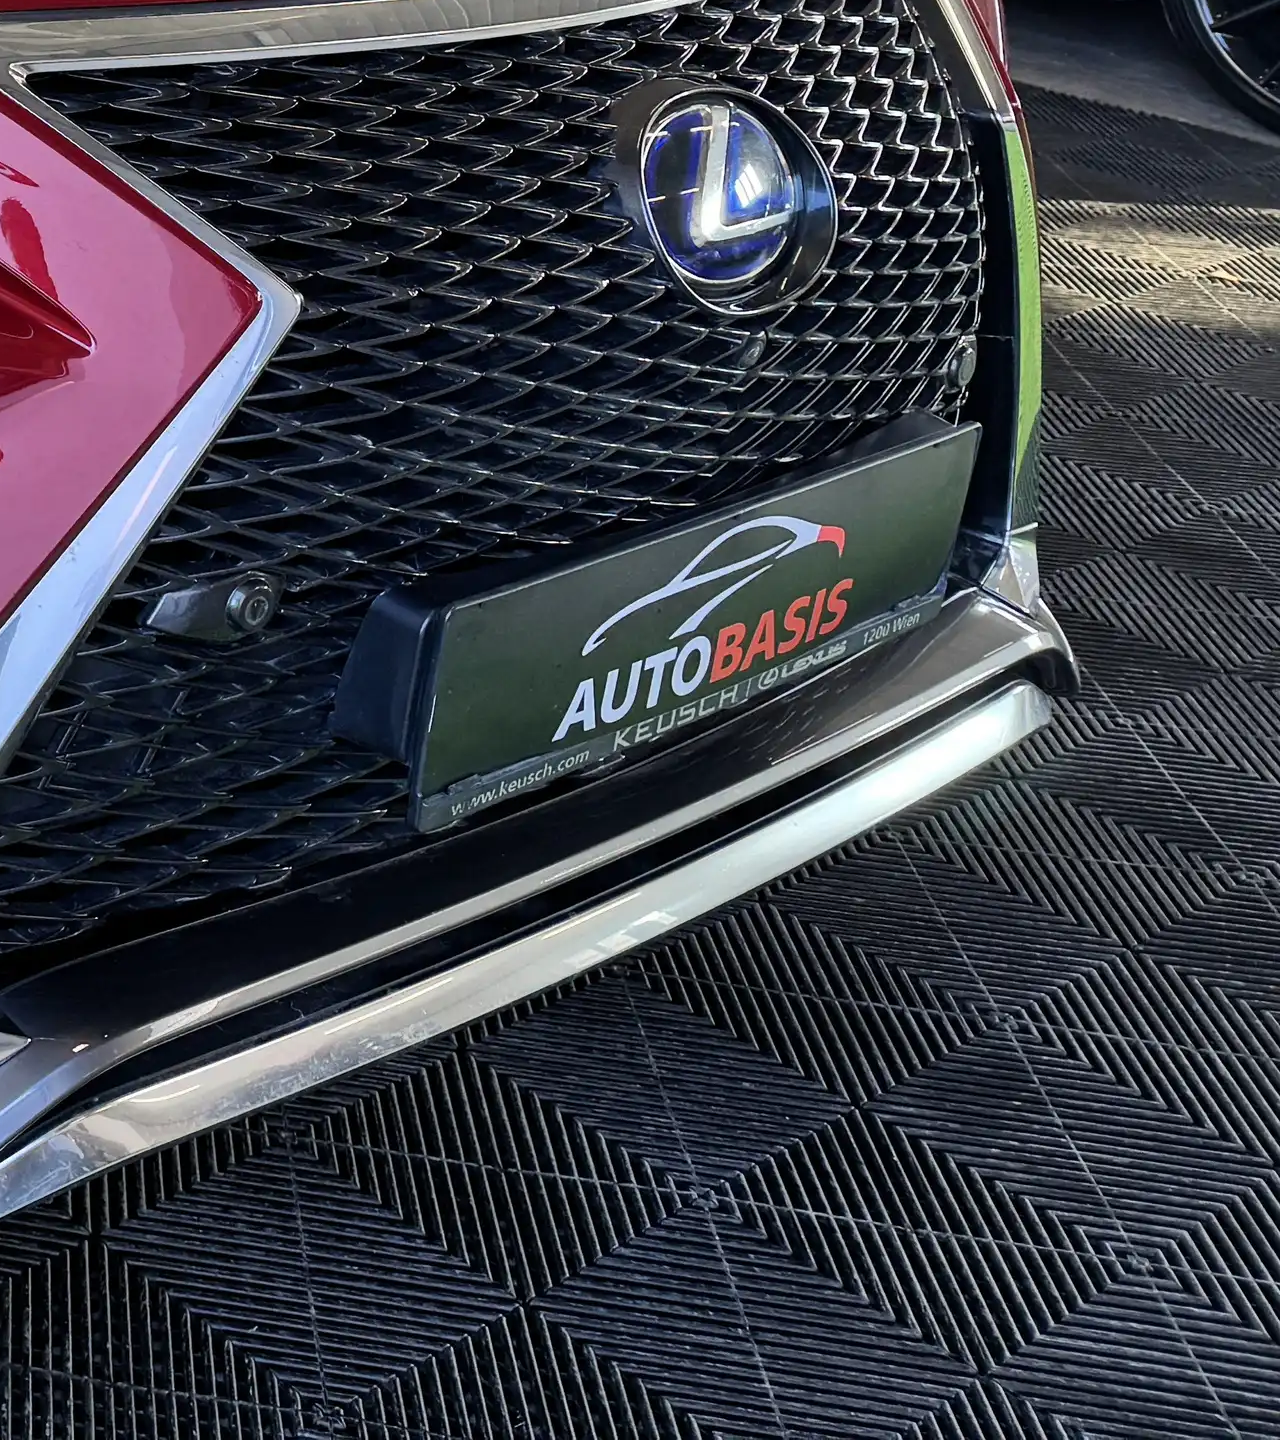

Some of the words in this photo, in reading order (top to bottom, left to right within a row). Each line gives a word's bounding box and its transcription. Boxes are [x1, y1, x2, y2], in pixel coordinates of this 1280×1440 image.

[451, 750, 591, 817] www.keusch.com
[612, 682, 741, 753] KEUSCH
[780, 639, 848, 679] LEXUS
[863, 622, 891, 646] 1200
[892, 612, 921, 634] Wien
[551, 578, 855, 743] AUTOBASIS
